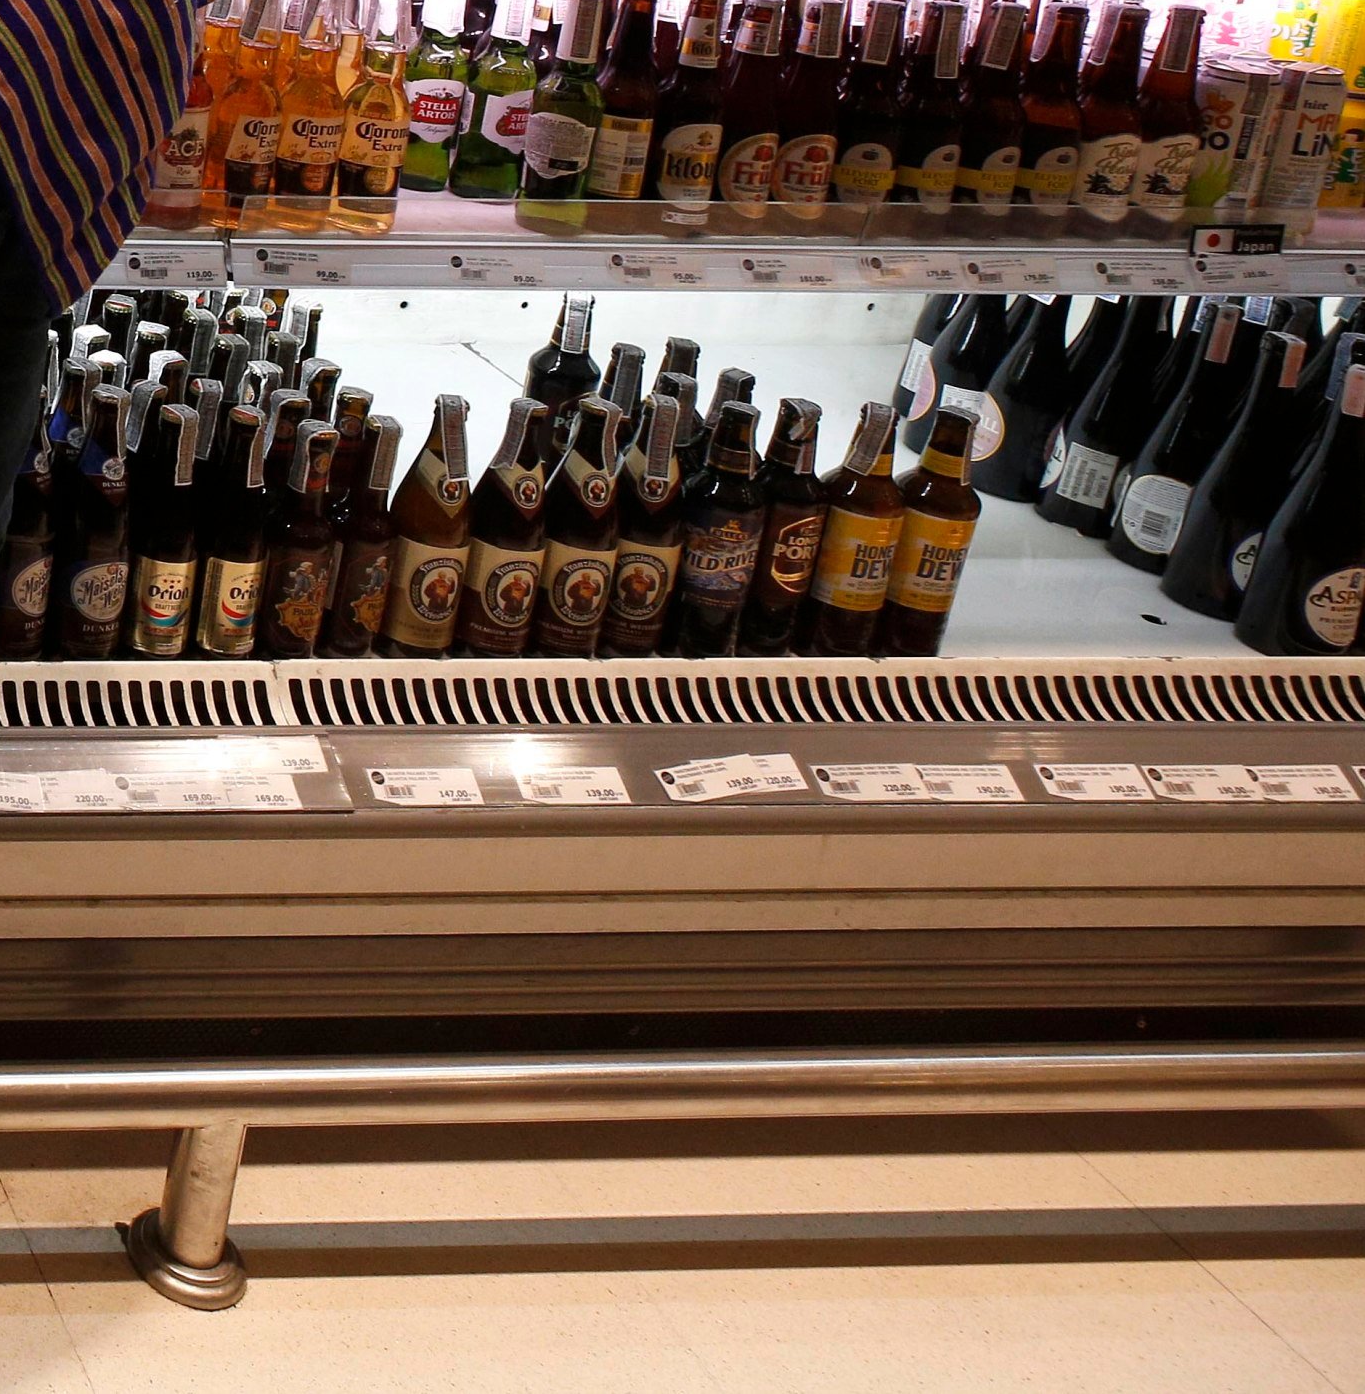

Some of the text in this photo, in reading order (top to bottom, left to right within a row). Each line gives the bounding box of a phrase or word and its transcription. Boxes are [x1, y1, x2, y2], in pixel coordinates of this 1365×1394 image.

[418, 100, 458, 114] STELLA
[372, 139, 403, 153] Extra
[1236, 238, 1275, 254] Japan
[186, 270, 213, 279] 119.00
[316, 271, 339, 279] 99.00
[148, 584, 189, 603] Orion
[438, 789, 469, 798] 147.00
[585, 788, 615, 797] 139.00
